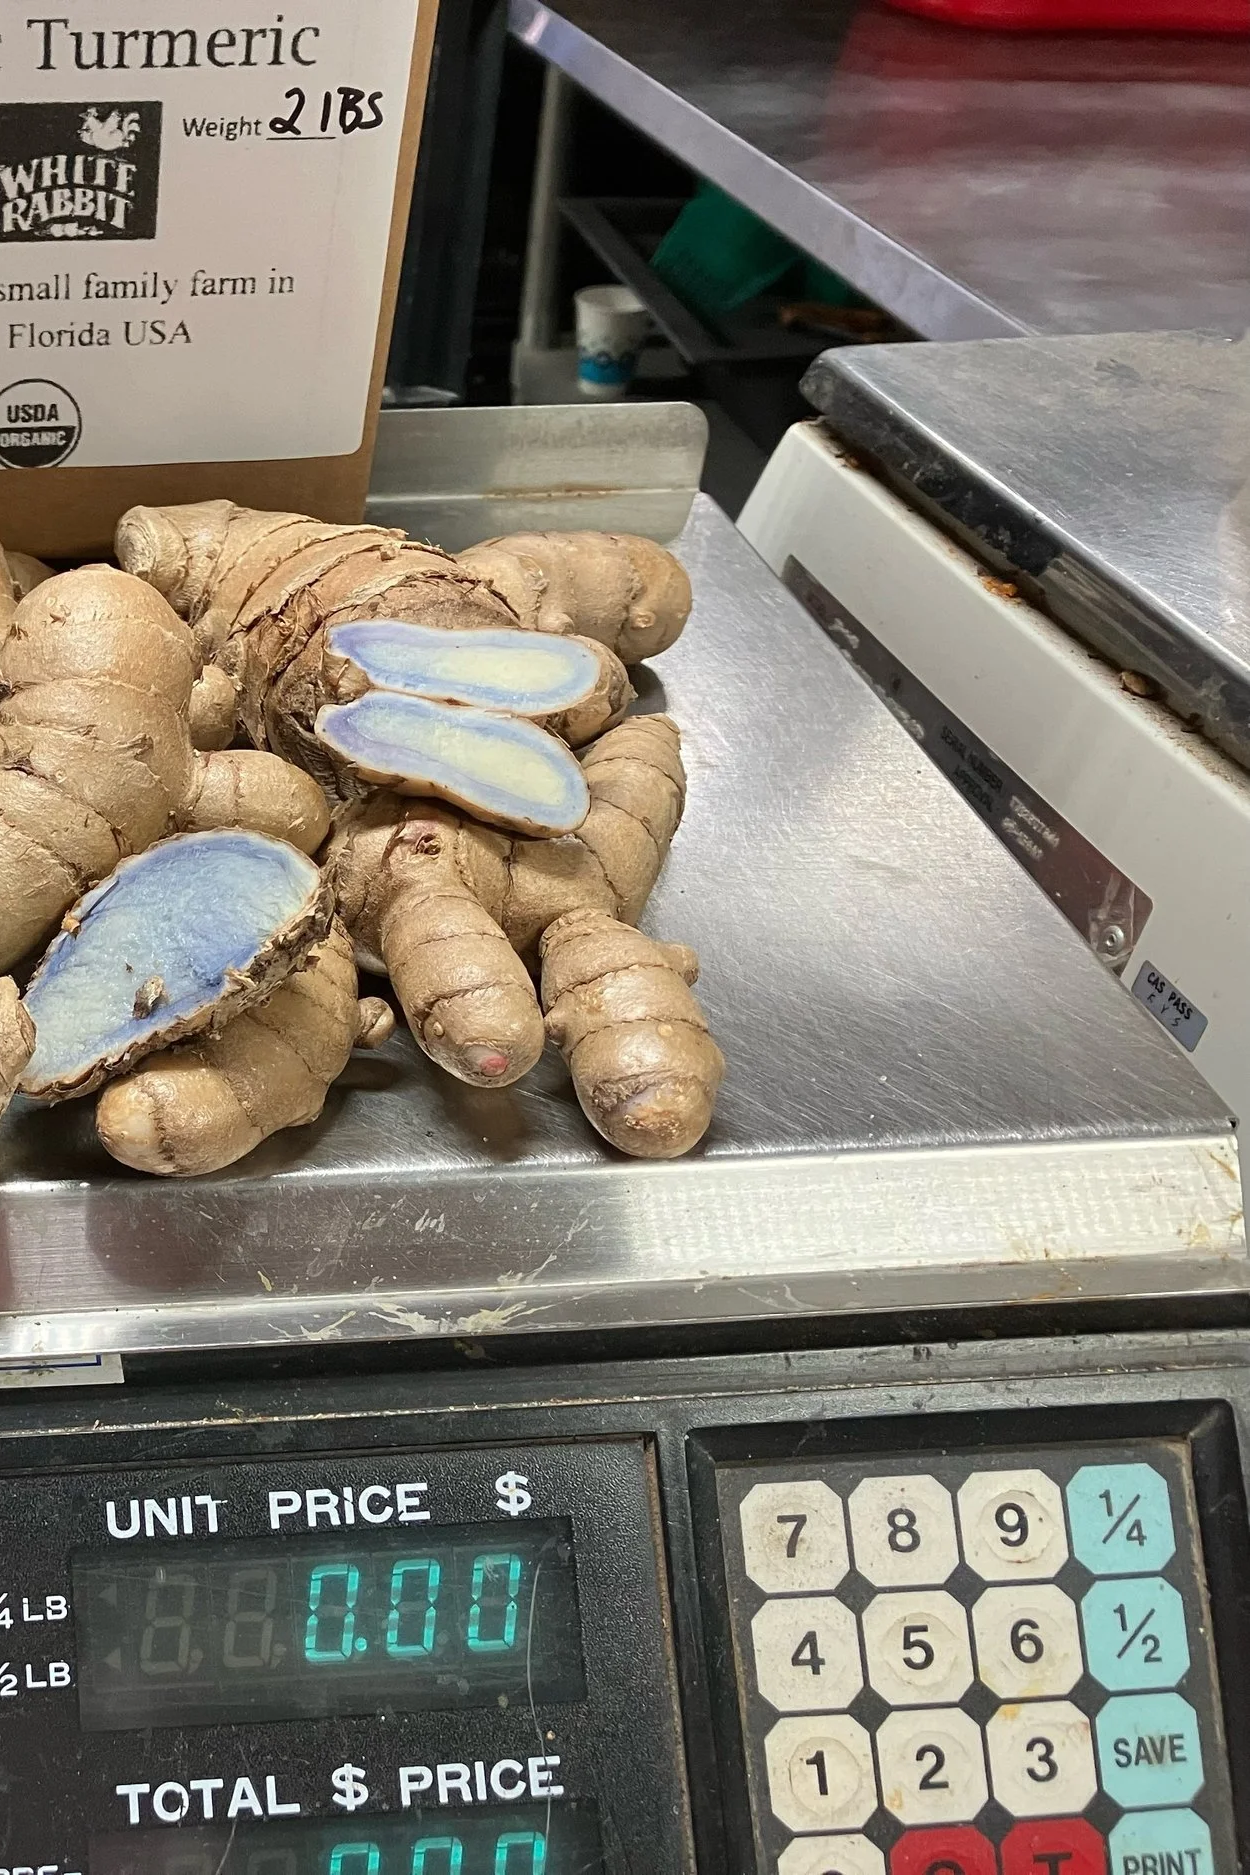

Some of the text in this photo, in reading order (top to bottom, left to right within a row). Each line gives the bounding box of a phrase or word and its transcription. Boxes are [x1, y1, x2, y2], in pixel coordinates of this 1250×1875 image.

[26, 14, 320, 71] Turmeric
[182, 115, 262, 141] Weight
[268, 86, 307, 136] 2
[0, 154, 138, 201] WHITE
[2, 188, 135, 233] RABBIT
[82, 270, 178, 305] family
[190, 269, 257, 298] farm
[268, 267, 295, 295] in
[8, 321, 111, 349] Florida
[123, 319, 193, 347] USA
[6, 403, 60, 425] USDA
[0, 431, 67, 448] ORGANIC
[1168, 991, 1194, 1020] PASS
[105, 1470, 532, 1540] UNIT PRICE $
[994, 1501, 1029, 1547] 9
[776, 1514, 808, 1559] 7
[887, 1507, 922, 1553] 8
[22, 1594, 69, 1623] LB
[304, 1553, 522, 1665] 0.00
[790, 1630, 826, 1676] 4
[901, 1624, 935, 1671] 5
[1010, 1618, 1045, 1664] 6
[25, 1660, 71, 1690] LB
[804, 1749, 830, 1797] 1
[915, 1743, 950, 1791] 2
[1026, 1736, 1059, 1783] 3
[1112, 1733, 1188, 1769] SAVE
[116, 1755, 565, 1826] TOTAL $ PRICE
[1123, 1847, 1202, 1875] PRINT
